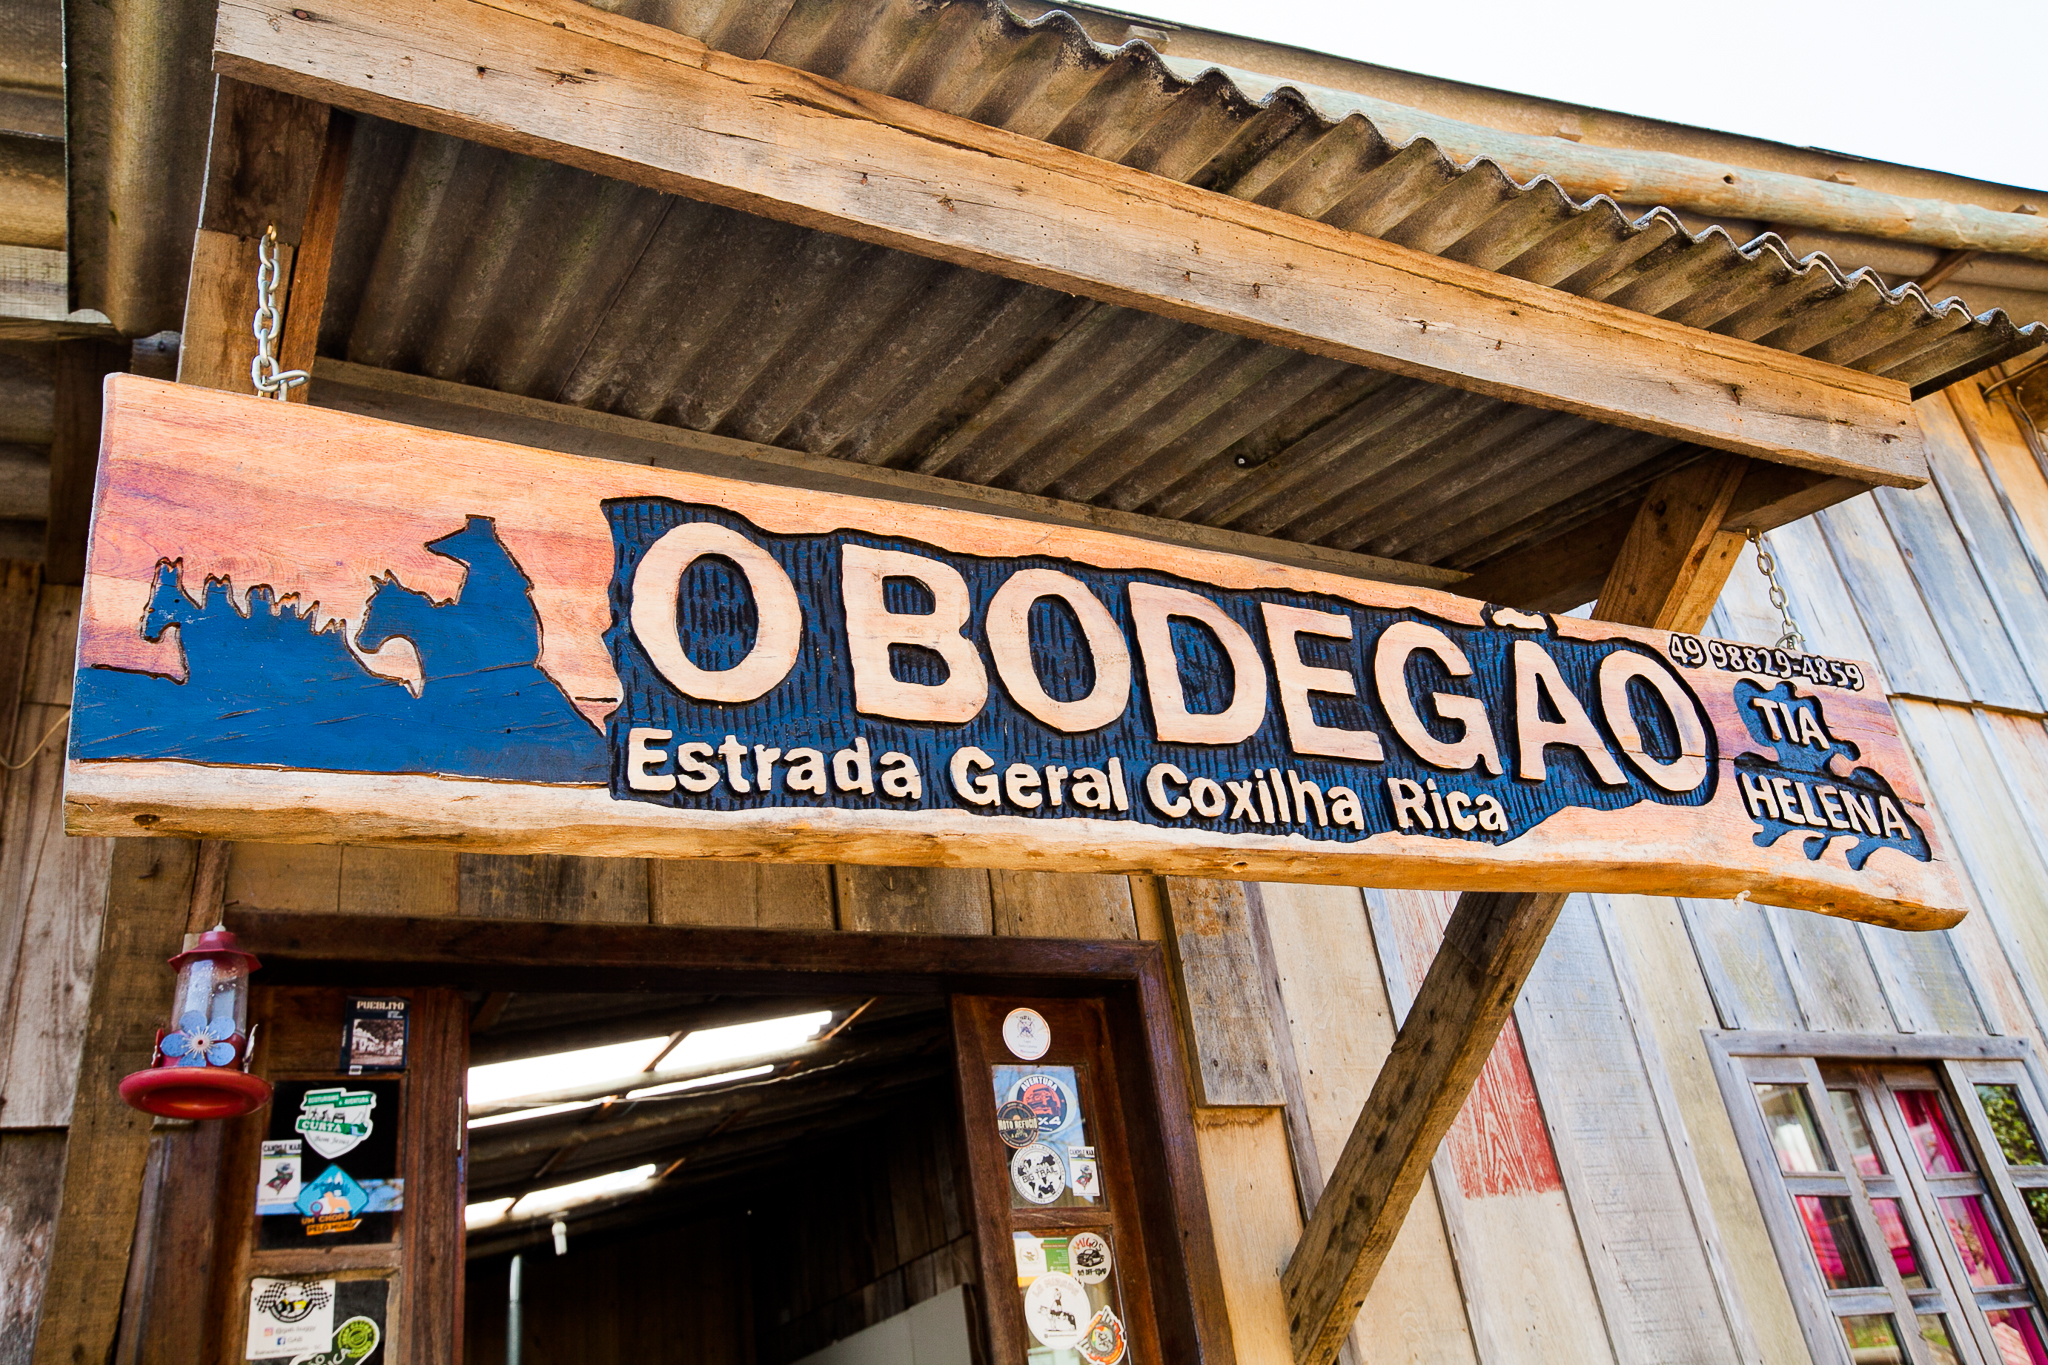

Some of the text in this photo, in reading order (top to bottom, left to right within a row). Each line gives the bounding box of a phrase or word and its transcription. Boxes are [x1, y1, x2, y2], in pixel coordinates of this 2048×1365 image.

[631, 522, 1708, 792] O BODEGÃO
[1671, 635, 1864, 691] 49 98829-4859
[1753, 697, 1830, 751] TIA
[627, 728, 1510, 832] Estrada Geral Coxilha Rica
[1740, 771, 1913, 841] HELENA
[356, 1000, 405, 1011] PUEBLITO
[1020, 1076, 1058, 1091] AVENTURA
[301, 1120, 342, 1133] CURTA
[1035, 1166, 1058, 1179] TRAIL
